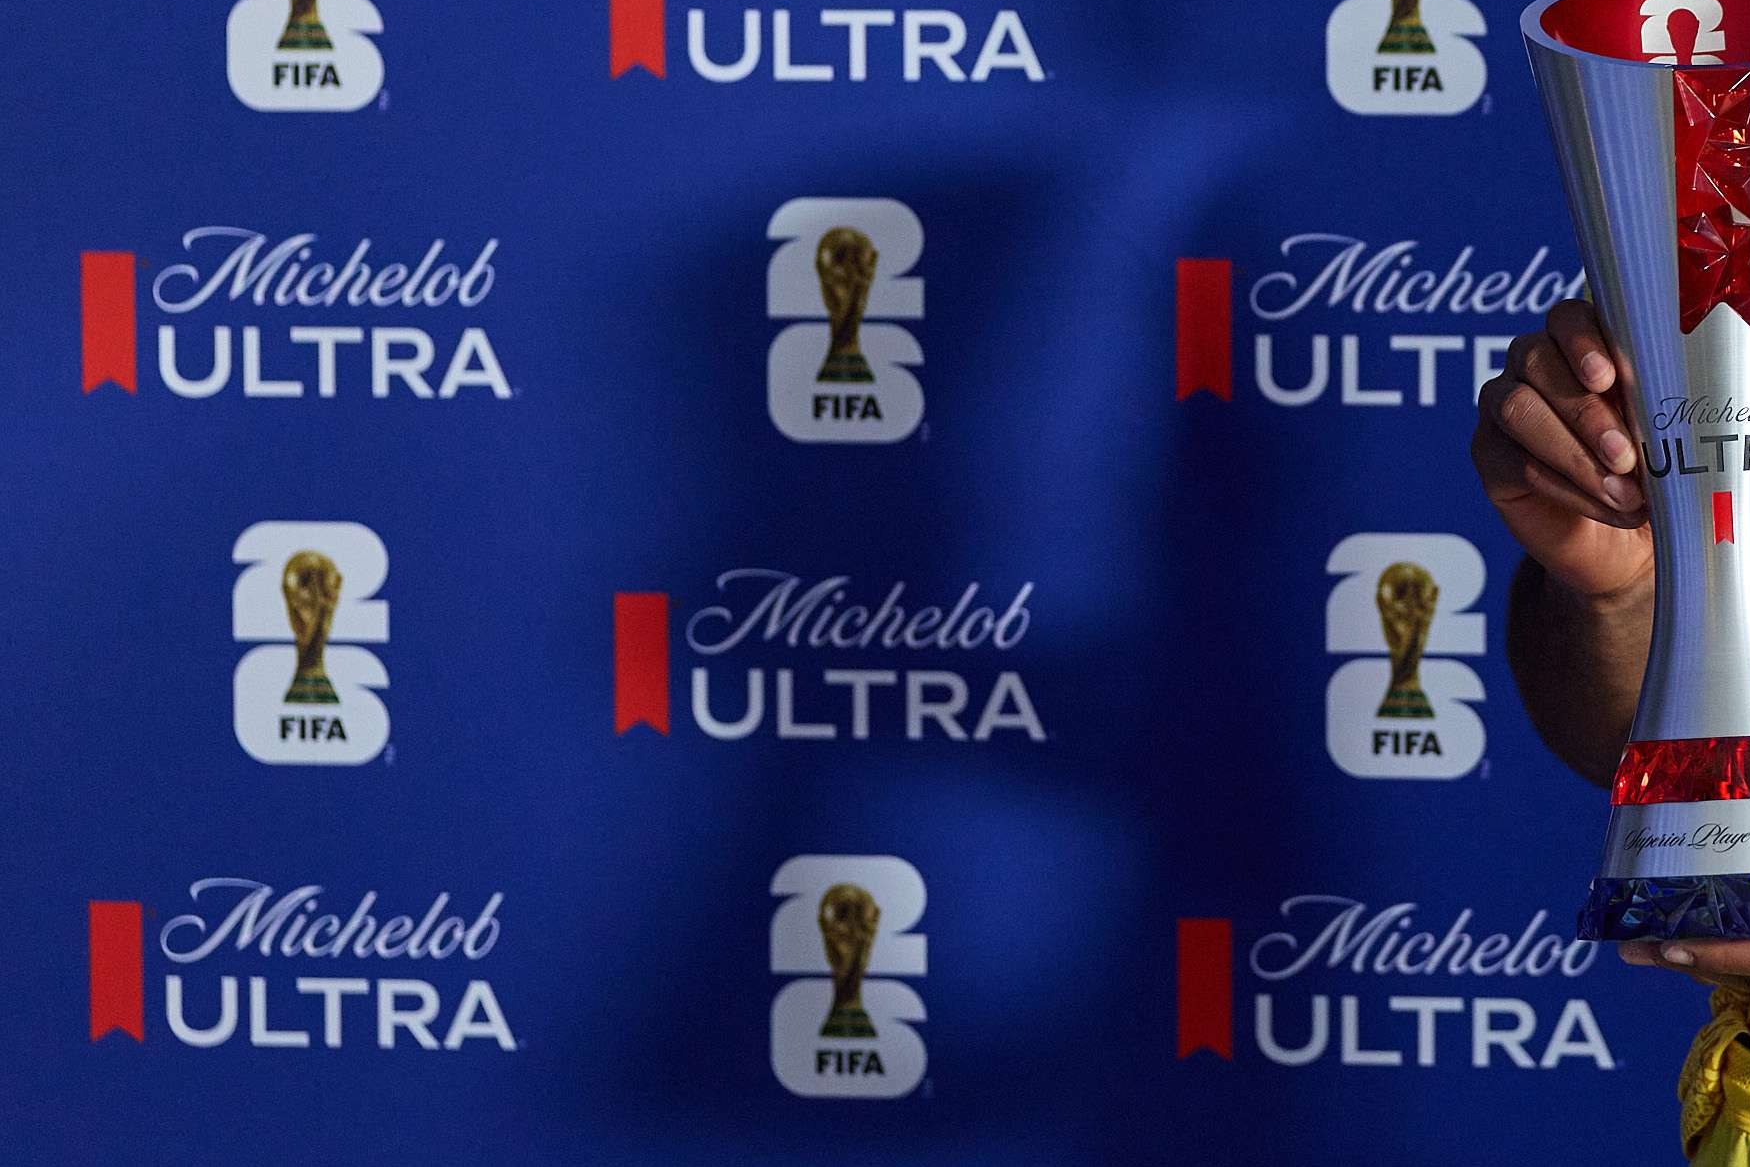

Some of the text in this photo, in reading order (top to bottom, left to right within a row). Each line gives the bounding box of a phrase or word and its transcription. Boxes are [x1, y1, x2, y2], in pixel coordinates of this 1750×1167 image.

[273, 63, 341, 88] FIFA
[687, 8, 1046, 83] ULTRA
[1373, 66, 1444, 92] FIFA
[152, 226, 499, 314] Michelob
[1250, 233, 1587, 320] Michelo
[157, 324, 513, 400] ULTRA
[812, 394, 883, 421] FIFA
[686, 569, 1035, 655] Michelob
[279, 716, 347, 741] FIFA
[691, 666, 1045, 742] ULTRA
[1372, 730, 1442, 757] FIFA
[1623, 825, 1686, 856] Superior
[160, 877, 504, 963] Michelob
[165, 974, 516, 1051] ULTRA
[1256, 994, 1616, 1070] ULTRA
[815, 1049, 886, 1075] FIFA
